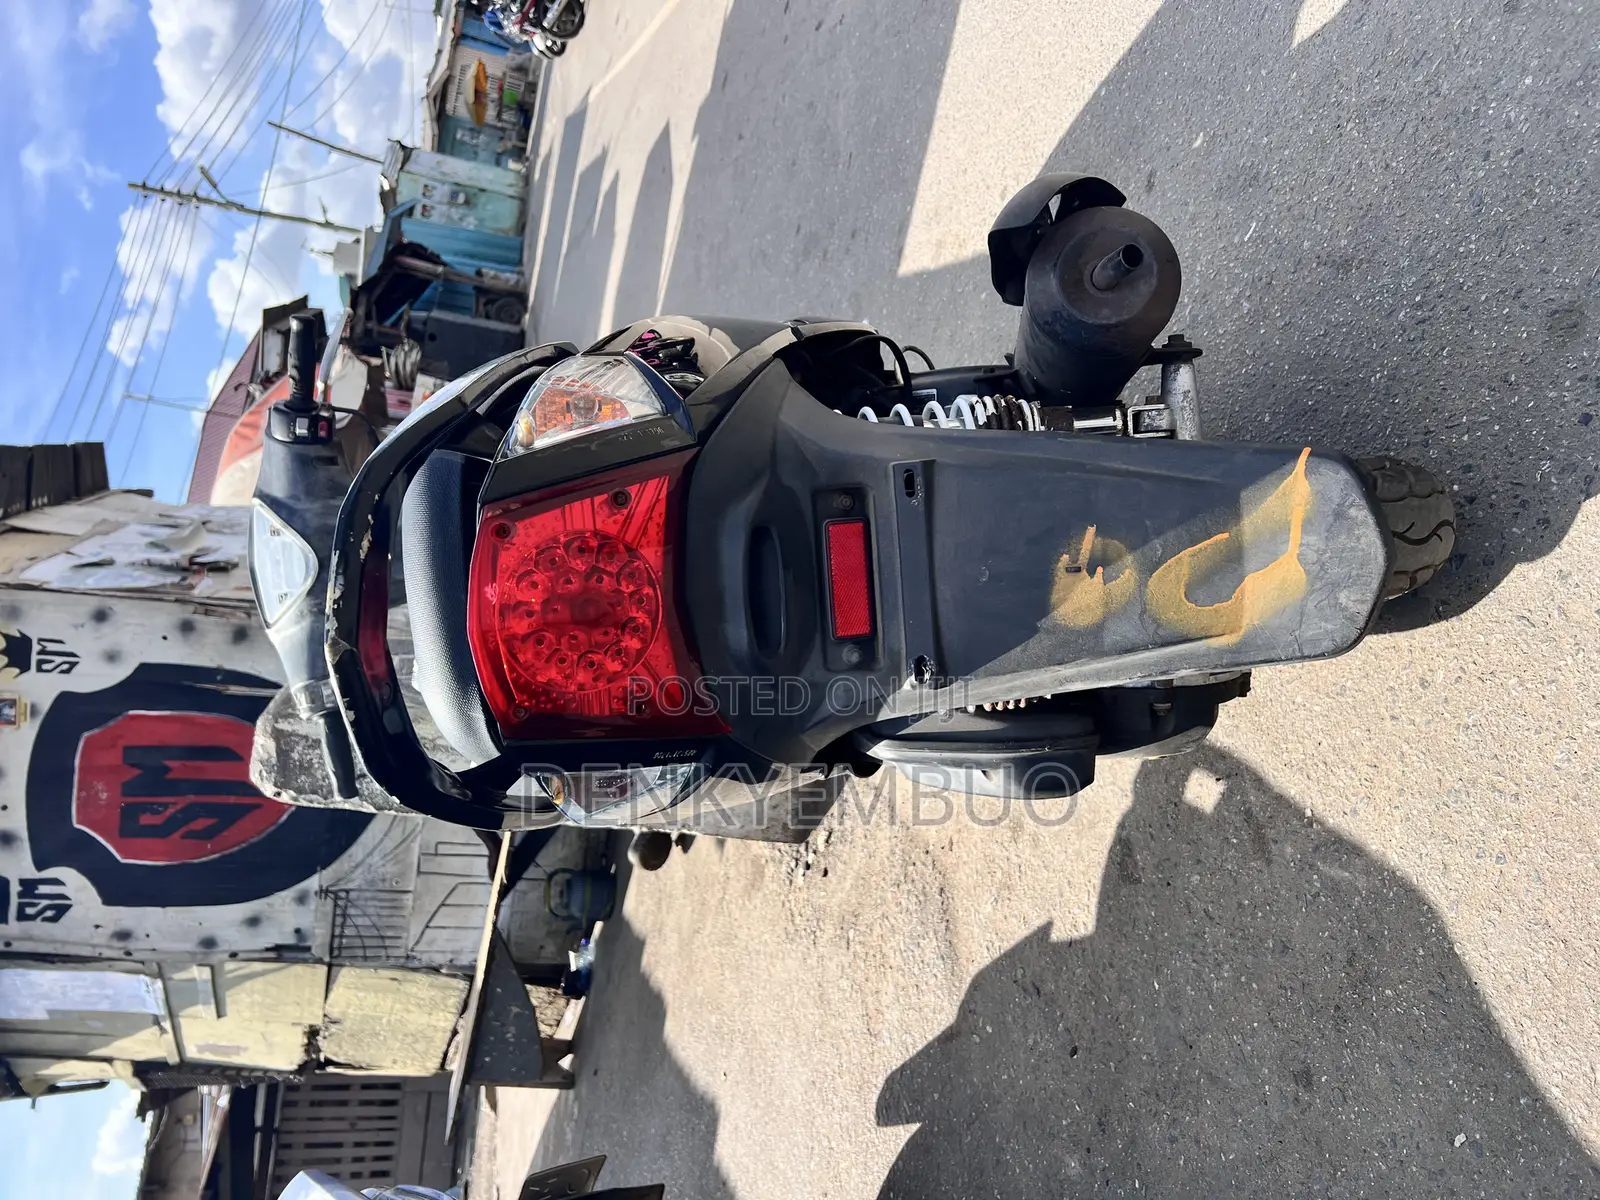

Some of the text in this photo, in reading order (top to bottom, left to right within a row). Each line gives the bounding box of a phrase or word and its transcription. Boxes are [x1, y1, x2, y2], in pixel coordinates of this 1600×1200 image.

[36, 638, 80, 674] SM
[120, 746, 262, 840] SM
[16, 878, 73, 922] SM
